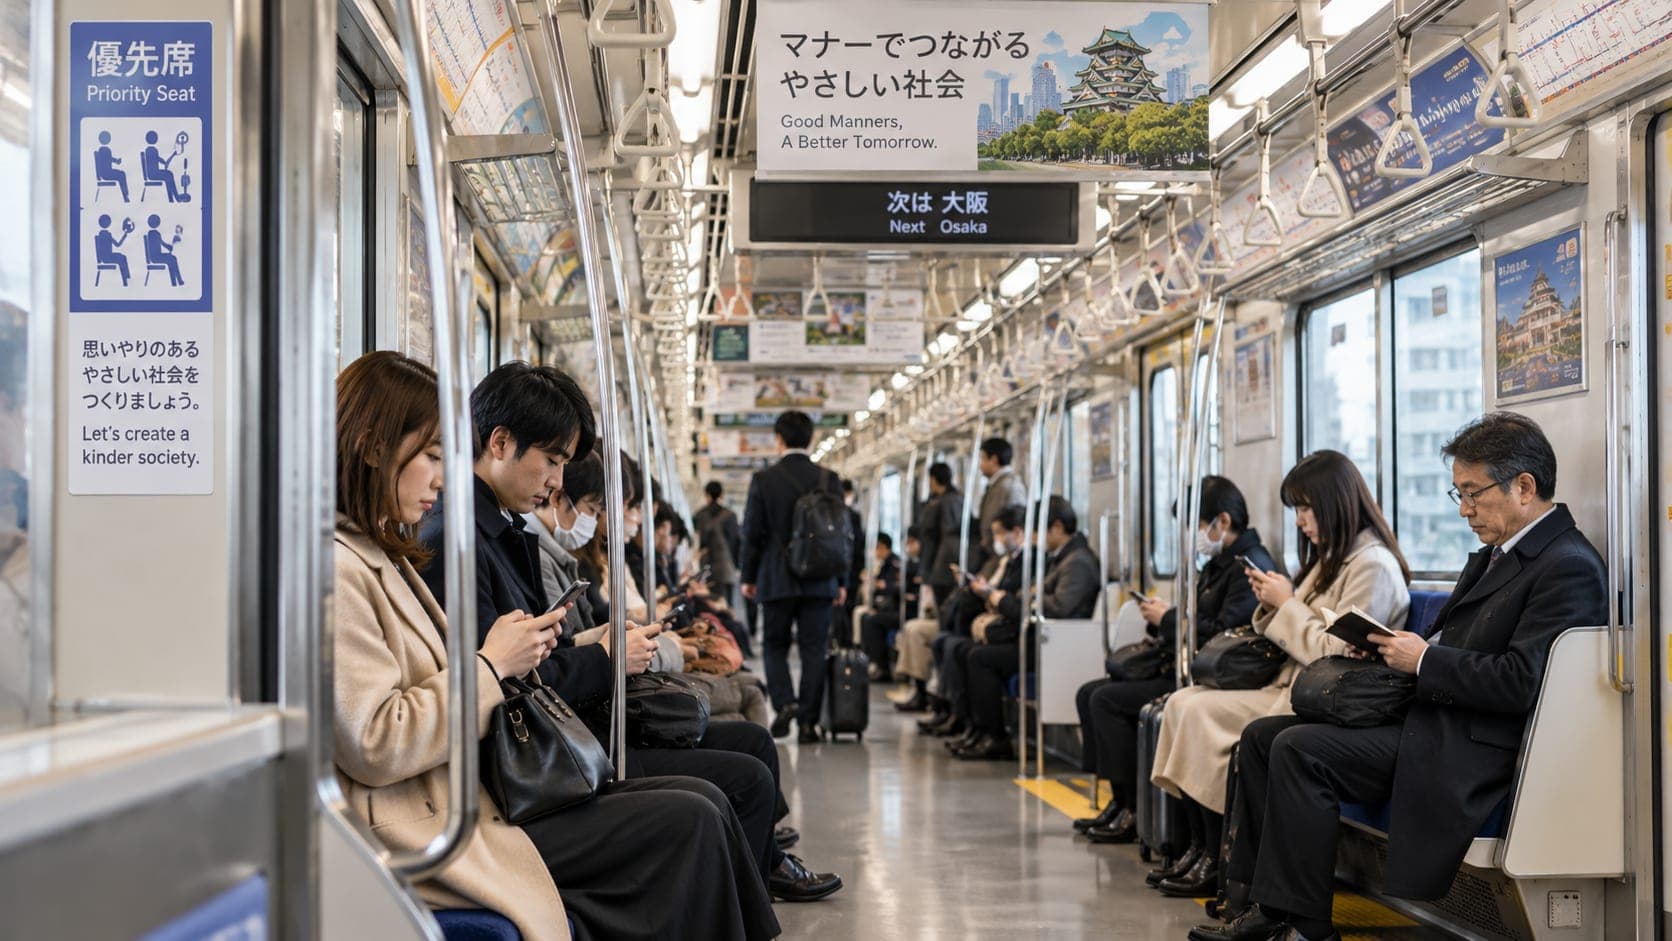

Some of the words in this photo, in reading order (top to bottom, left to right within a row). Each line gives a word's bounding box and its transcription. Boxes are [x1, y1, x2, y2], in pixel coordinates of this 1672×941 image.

[780, 29, 1030, 60] マナーでつながる
[87, 40, 196, 78] 優先席
[780, 68, 965, 100] やさしい社会
[87, 84, 151, 106] Priority
[156, 84, 196, 102] Seat
[780, 113, 824, 129] Good
[829, 113, 903, 131] Manners,
[780, 134, 793, 149] A
[798, 134, 848, 149] Better
[852, 134, 938, 149] Tomorrow.
[886, 190, 933, 214] 次は
[941, 190, 989, 215] 大阪
[889, 219, 926, 234] Next
[940, 219, 988, 234] Osaka
[82, 339, 200, 359] 思いやりのある
[82, 364, 200, 385] やさしい社会を
[82, 391, 200, 411] つくりましょう。
[82, 425, 121, 442] Let's
[124, 426, 176, 442] create
[180, 428, 190, 442] a
[82, 448, 134, 465] kinder
[138, 448, 200, 469] society.
